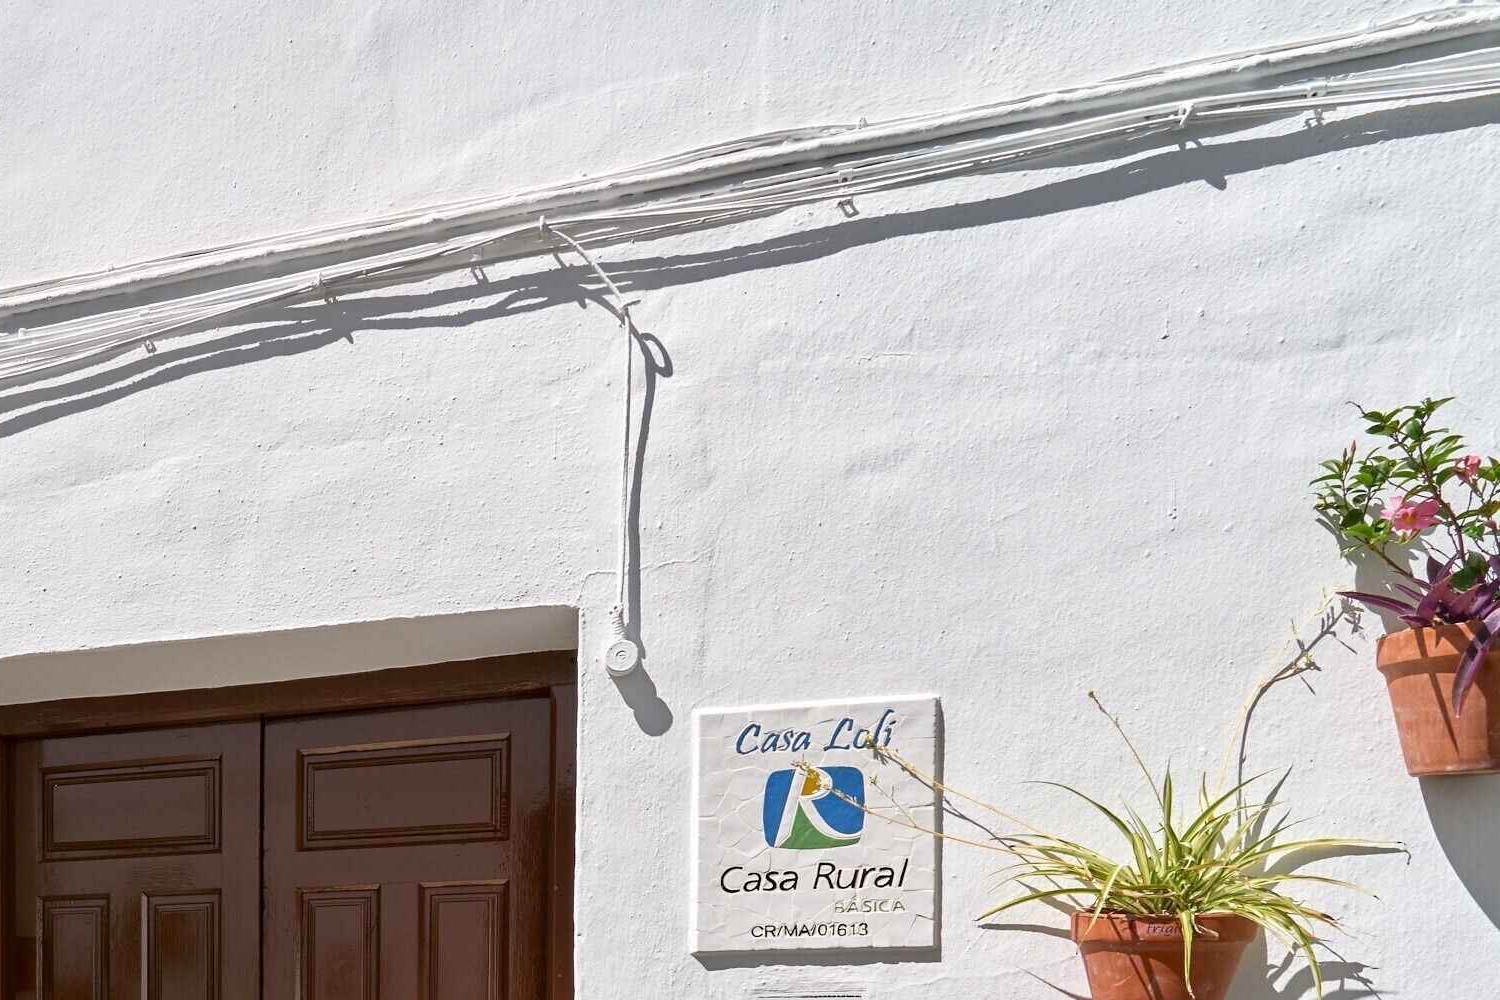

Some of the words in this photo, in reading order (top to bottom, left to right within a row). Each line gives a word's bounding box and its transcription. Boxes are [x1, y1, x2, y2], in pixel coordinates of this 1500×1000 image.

[736, 723, 811, 755] Casa
[823, 708, 897, 752] Loli
[720, 866, 799, 894] Casa
[812, 858, 909, 890] Rural
[834, 894, 906, 914] BÁSICA
[750, 922, 869, 939] CR/MA/01613
